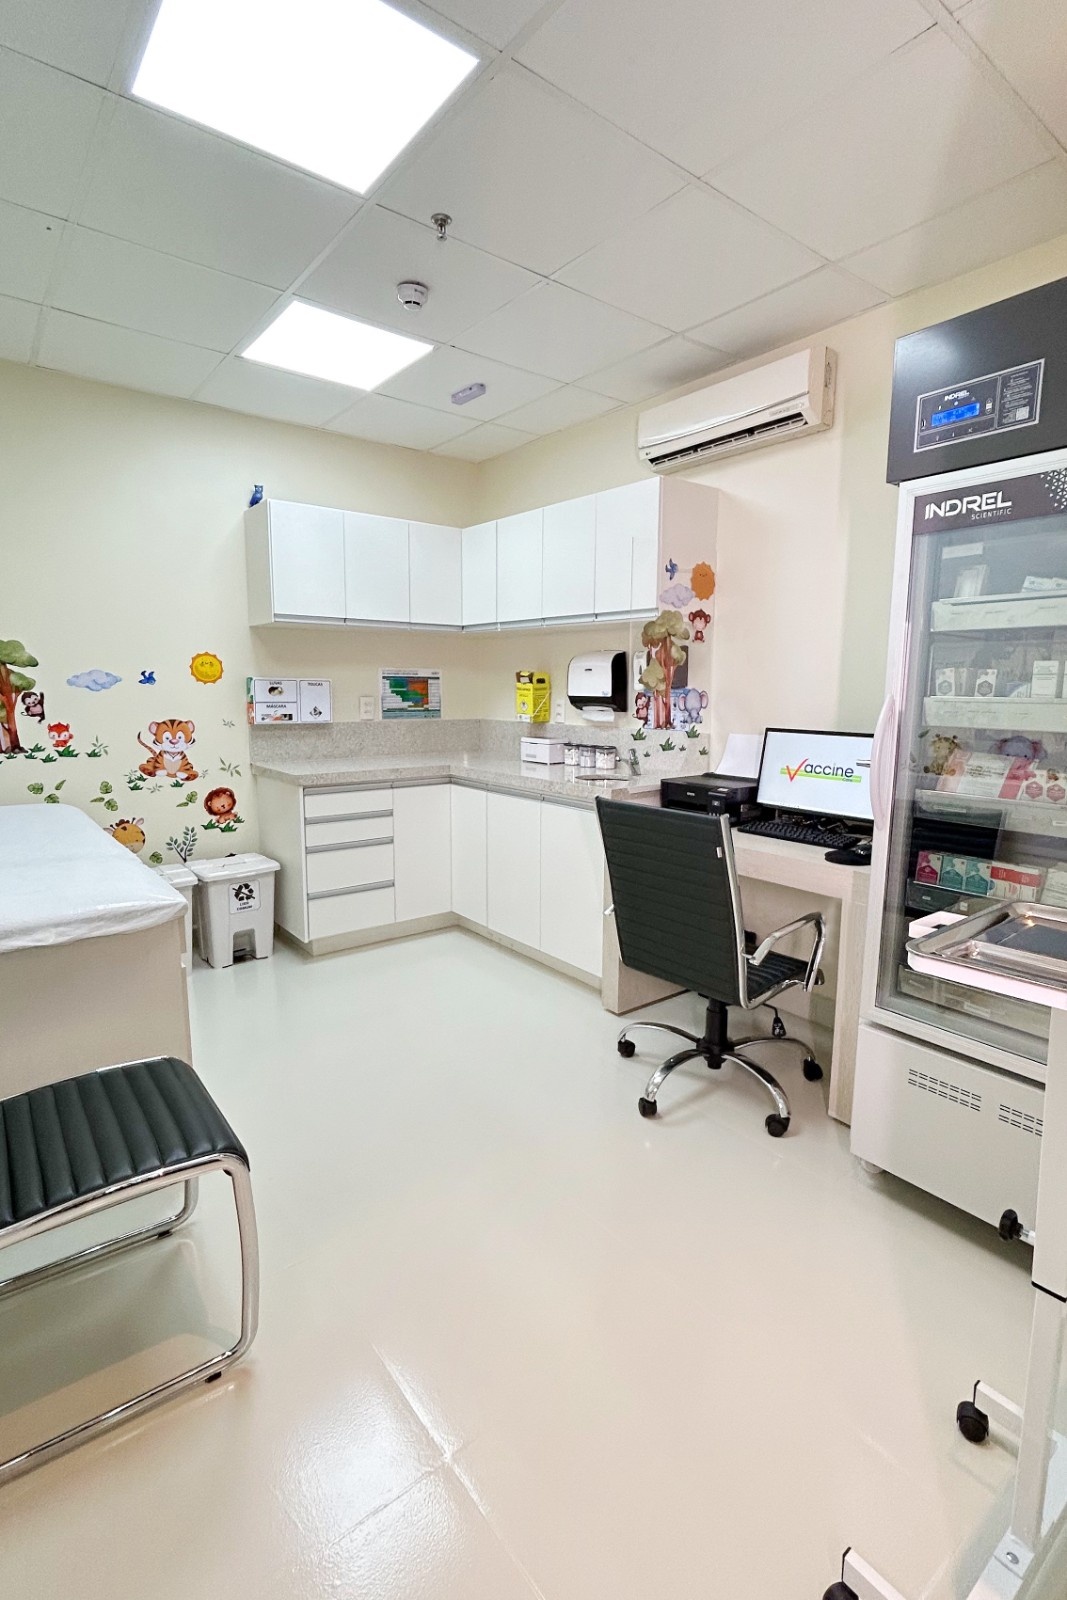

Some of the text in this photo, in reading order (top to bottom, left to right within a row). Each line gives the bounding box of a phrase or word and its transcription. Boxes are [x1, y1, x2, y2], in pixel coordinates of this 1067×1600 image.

[944, 390, 970, 401] INDREL
[924, 491, 1012, 520] INDREL
[971, 508, 1012, 520] SCIENTIFIC
[786, 758, 854, 782] Vaccine
